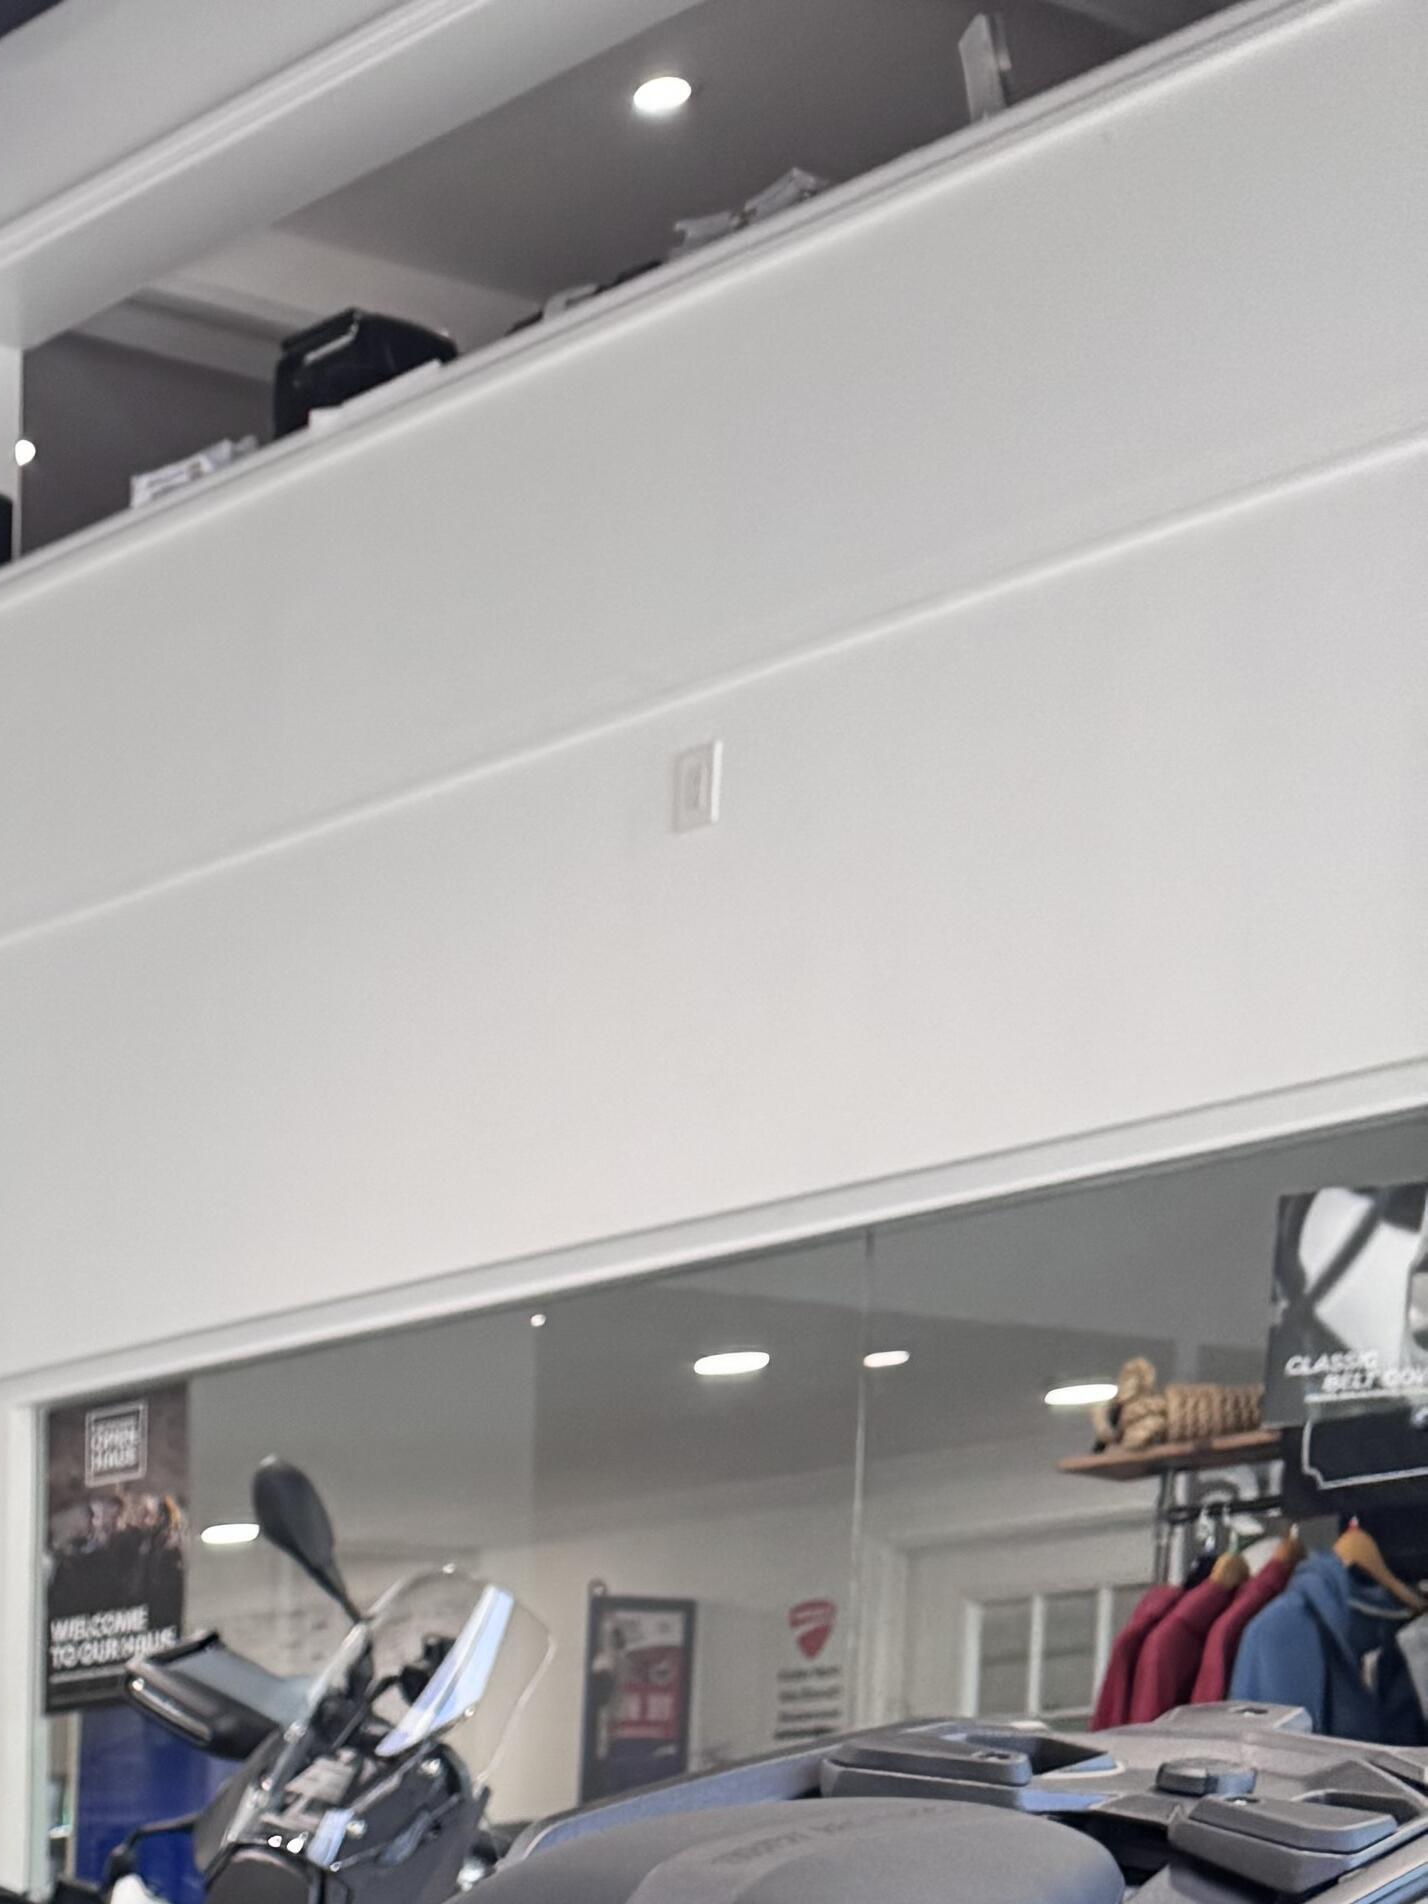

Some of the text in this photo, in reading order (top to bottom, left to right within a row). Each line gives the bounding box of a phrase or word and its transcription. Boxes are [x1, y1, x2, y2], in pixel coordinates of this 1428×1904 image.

[50, 1607, 149, 1641] WELCOME
[51, 1644, 80, 1669] TO
[81, 1638, 118, 1665] OUR
